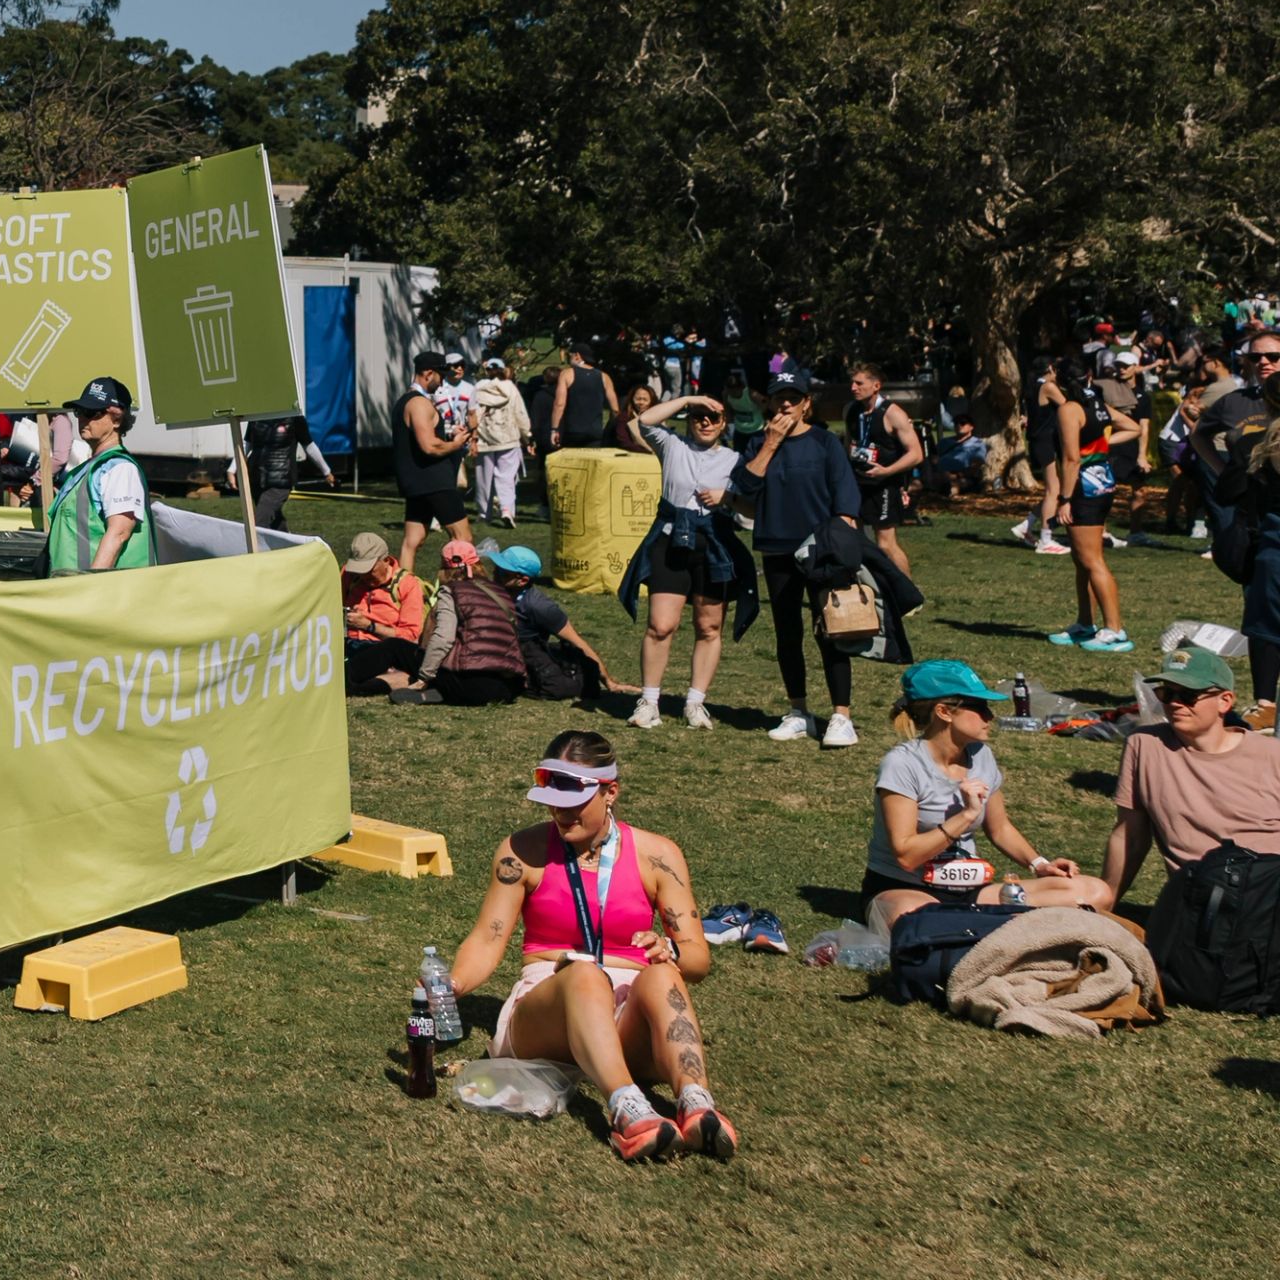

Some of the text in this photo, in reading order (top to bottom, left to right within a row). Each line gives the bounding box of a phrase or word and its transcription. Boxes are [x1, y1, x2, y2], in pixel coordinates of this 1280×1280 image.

[144, 200, 260, 259] GENERAL
[11, 614, 334, 749] RECYCLING HUB
[939, 867, 979, 882] 36167
